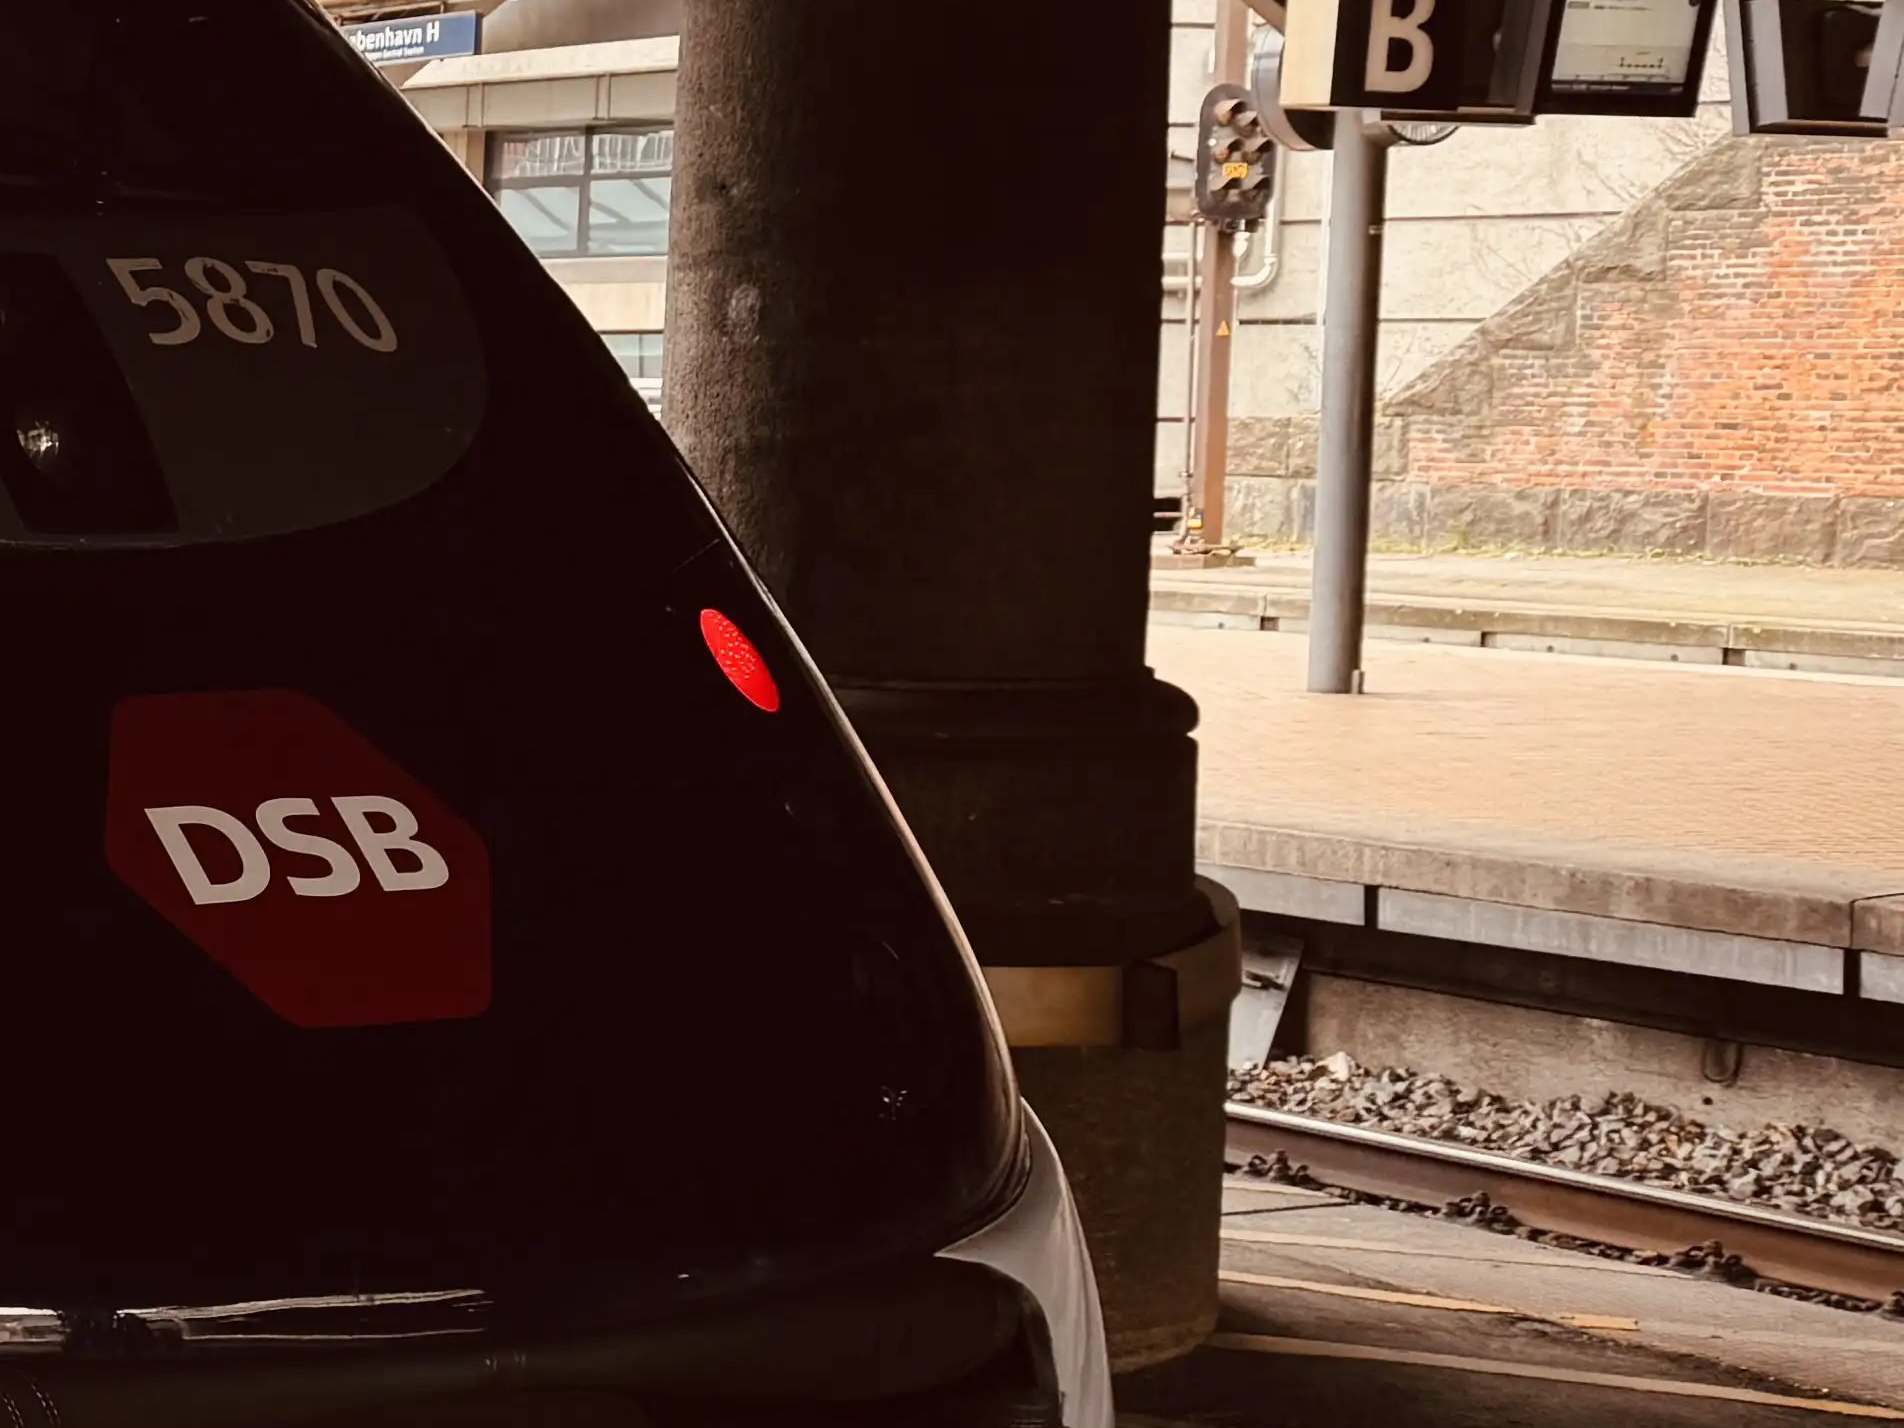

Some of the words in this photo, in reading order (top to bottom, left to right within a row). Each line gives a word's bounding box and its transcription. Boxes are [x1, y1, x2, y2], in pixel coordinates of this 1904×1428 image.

[349, 26, 423, 52] benhavn
[426, 20, 440, 43] H
[106, 257, 398, 352] 5870
[144, 795, 450, 905] DSB
